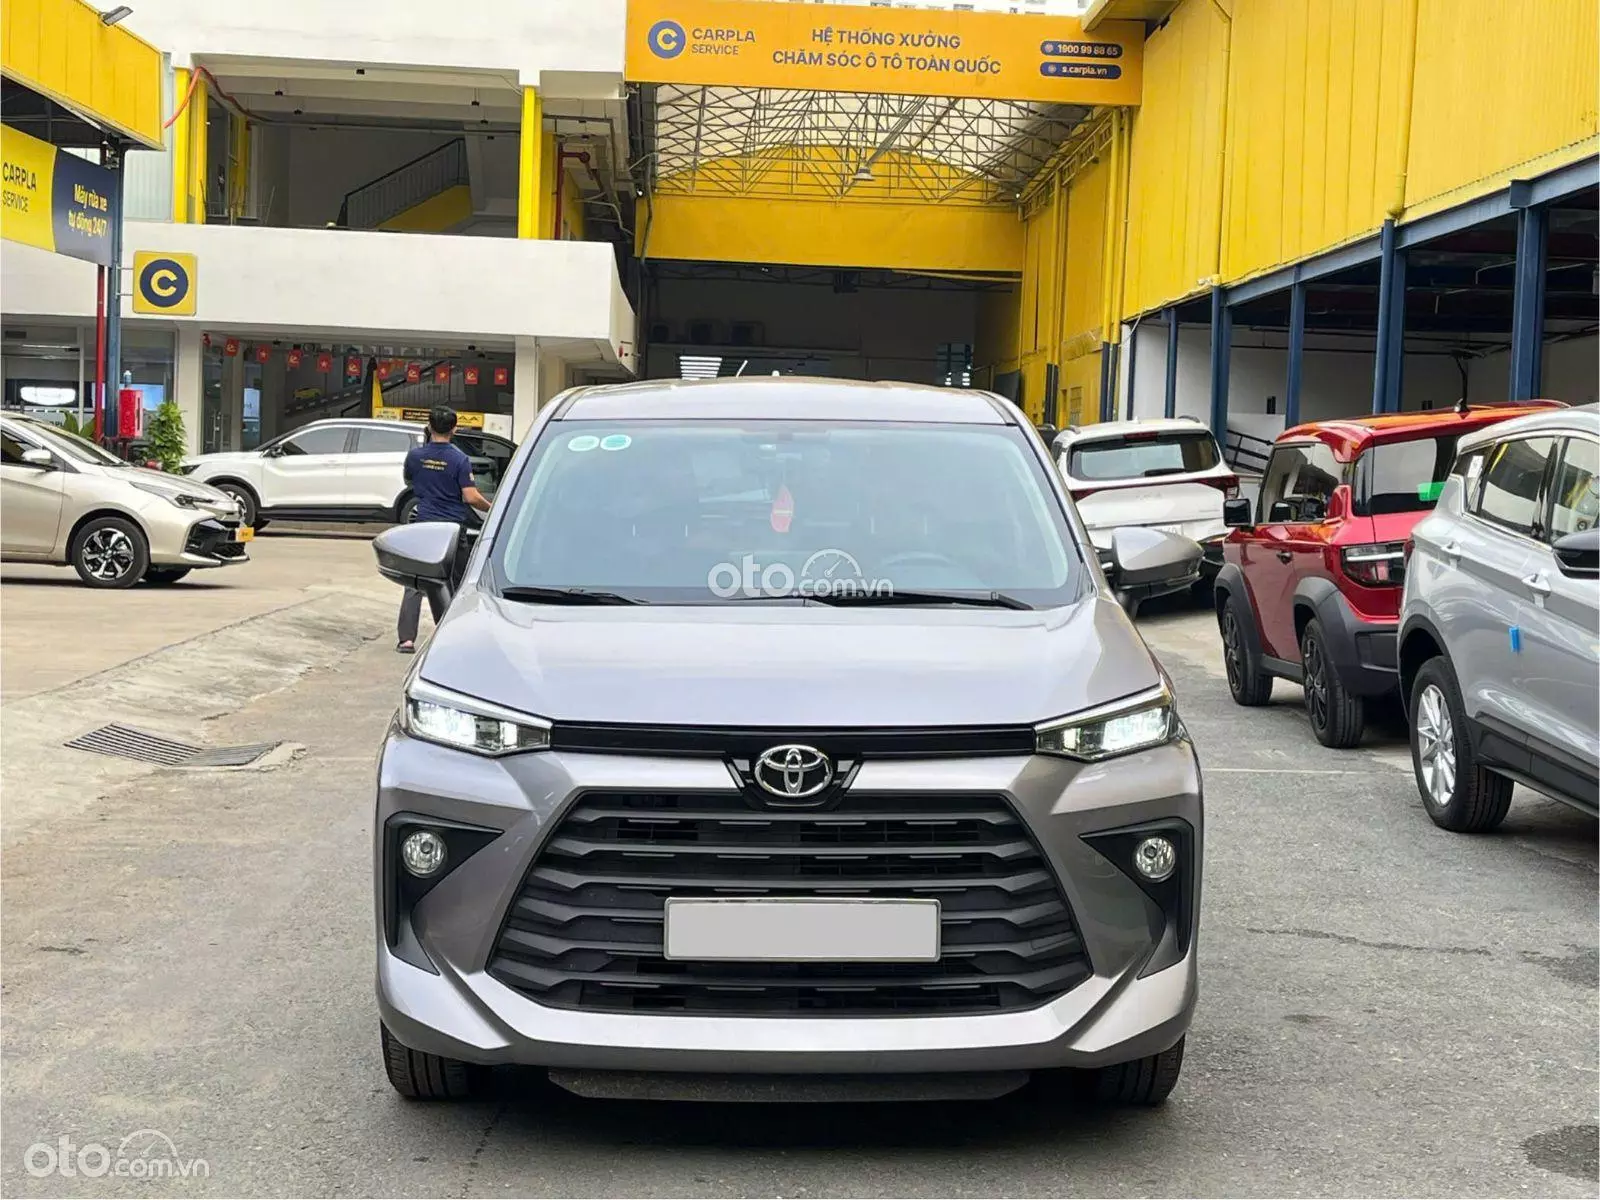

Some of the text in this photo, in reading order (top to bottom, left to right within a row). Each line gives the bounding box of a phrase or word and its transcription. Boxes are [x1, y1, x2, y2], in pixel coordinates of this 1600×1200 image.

[692, 28, 756, 43] CARPLA
[812, 26, 961, 50] HỆ THỐNG XƯỞNG
[691, 44, 739, 56] SERVICE
[1057, 44, 1080, 54] 1900
[772, 48, 1001, 75] CHĂM SÓC Ô TÔ TOÀN QUỐC
[3, 161, 37, 192] CARPLA
[2, 190, 29, 213] SERVICE
[74, 183, 88, 209] Máy
[92, 216, 107, 239] 24/7
